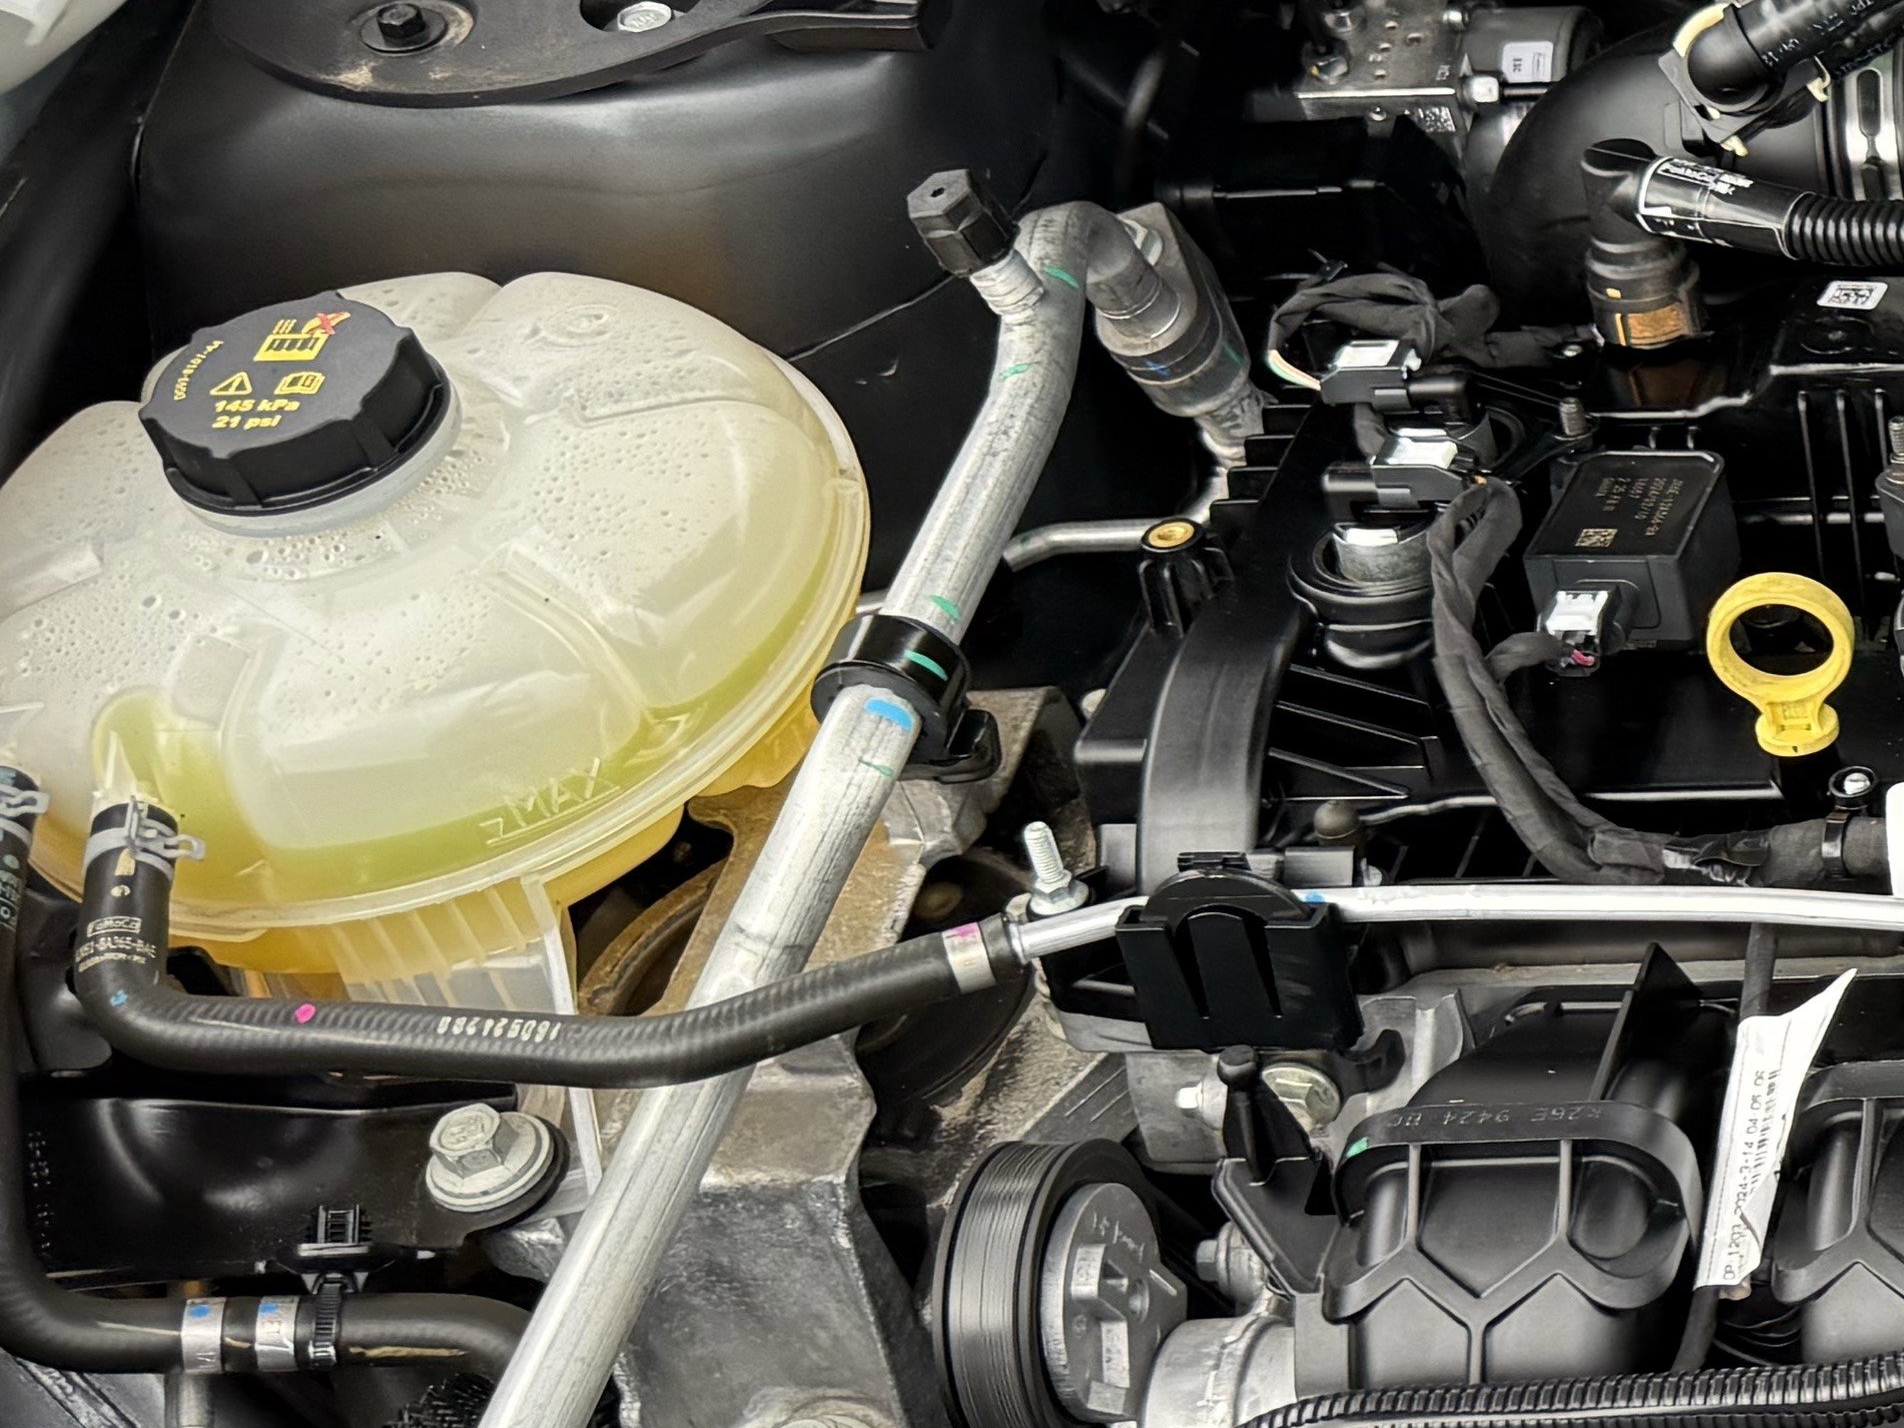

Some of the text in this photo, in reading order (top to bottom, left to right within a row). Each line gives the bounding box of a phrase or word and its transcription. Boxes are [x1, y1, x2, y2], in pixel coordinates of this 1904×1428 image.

[215, 399, 300, 413] 145 kPa
[211, 415, 283, 430] 21 psi
[506, 757, 616, 826] MAX
